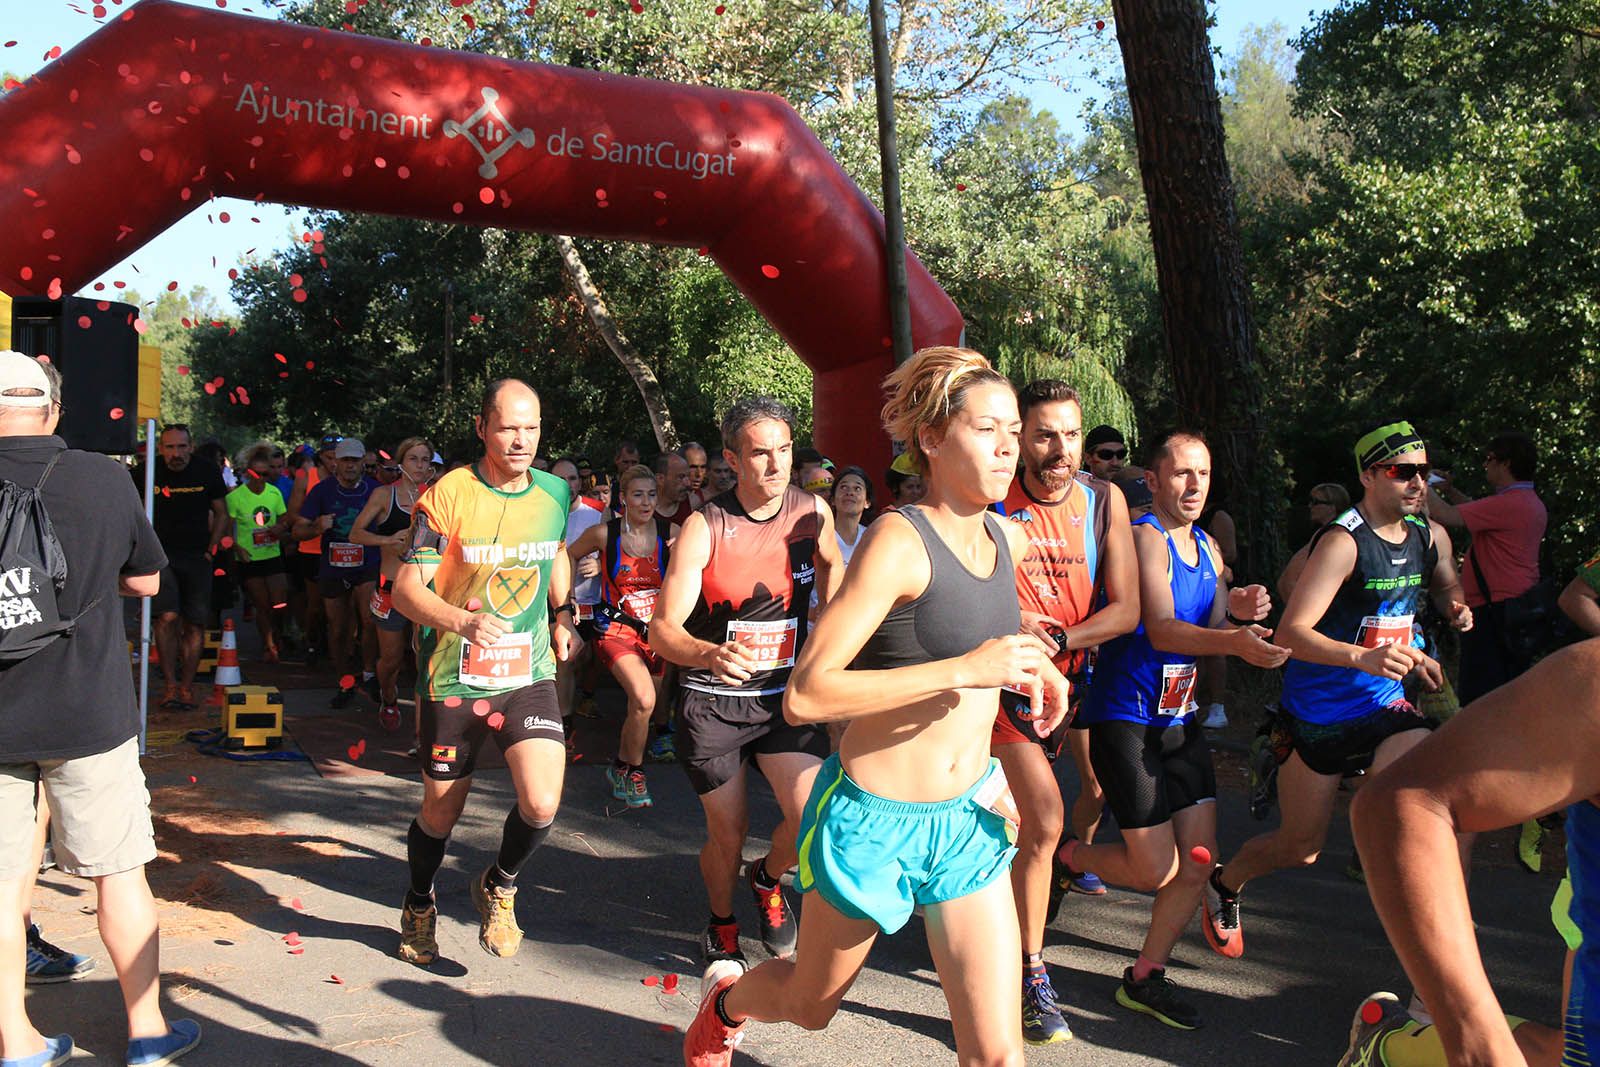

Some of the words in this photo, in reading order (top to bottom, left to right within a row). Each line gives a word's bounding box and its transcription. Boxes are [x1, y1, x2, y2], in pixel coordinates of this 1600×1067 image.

[235, 83, 433, 140] Ajuntament
[546, 127, 584, 158] de
[591, 132, 737, 180] SantCugat
[629, 597, 655, 609] VALLE
[477, 648, 522, 662] JAVIER
[490, 662, 510, 676] 41
